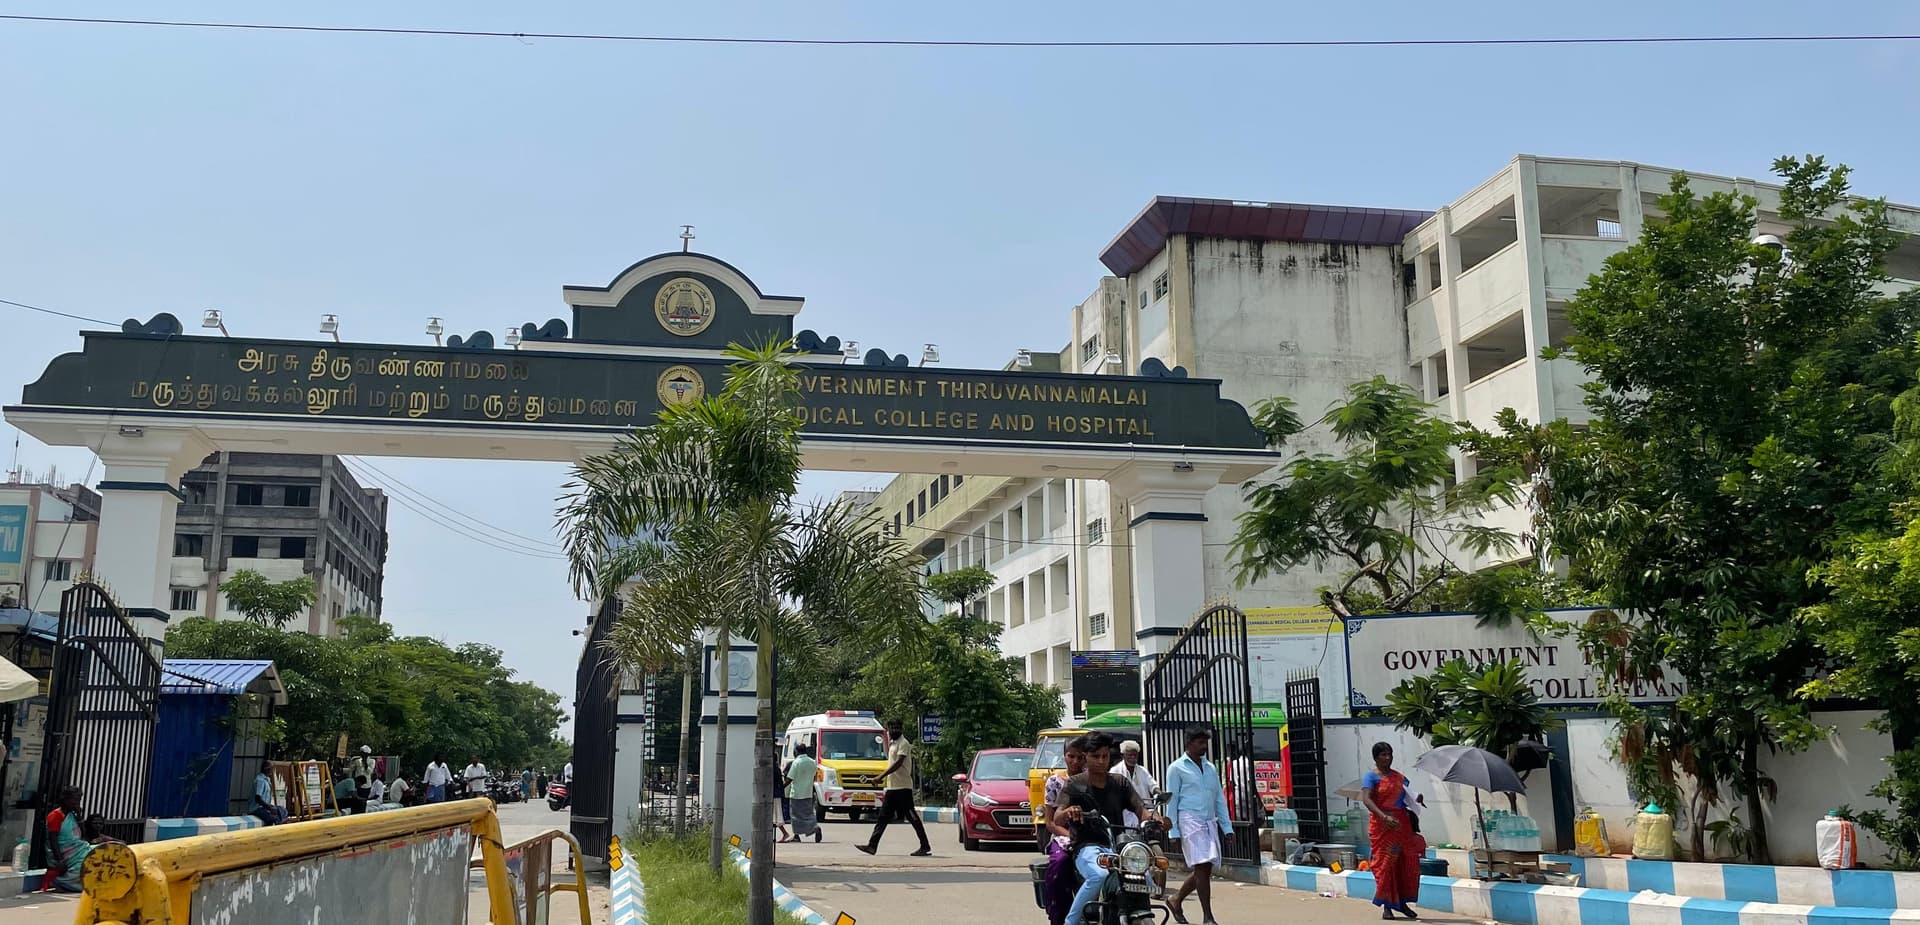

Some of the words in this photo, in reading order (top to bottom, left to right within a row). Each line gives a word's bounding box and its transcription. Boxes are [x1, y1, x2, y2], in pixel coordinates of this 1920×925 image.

[237, 348, 300, 375] அரசு
[308, 348, 529, 381] திருவண்ணாமலை
[368, 384, 450, 418] மற்றும்
[462, 388, 638, 422] மருத்துவமனை
[787, 374, 927, 398] OVERNMENT
[937, 381, 1148, 406] THIRUVANNAMALAI
[793, 406, 864, 427] DICAL
[874, 408, 979, 431] COLLEGE
[989, 413, 1034, 432] AND
[1047, 415, 1154, 437] HOSPITAL
[1655, 682, 1689, 698] AN
